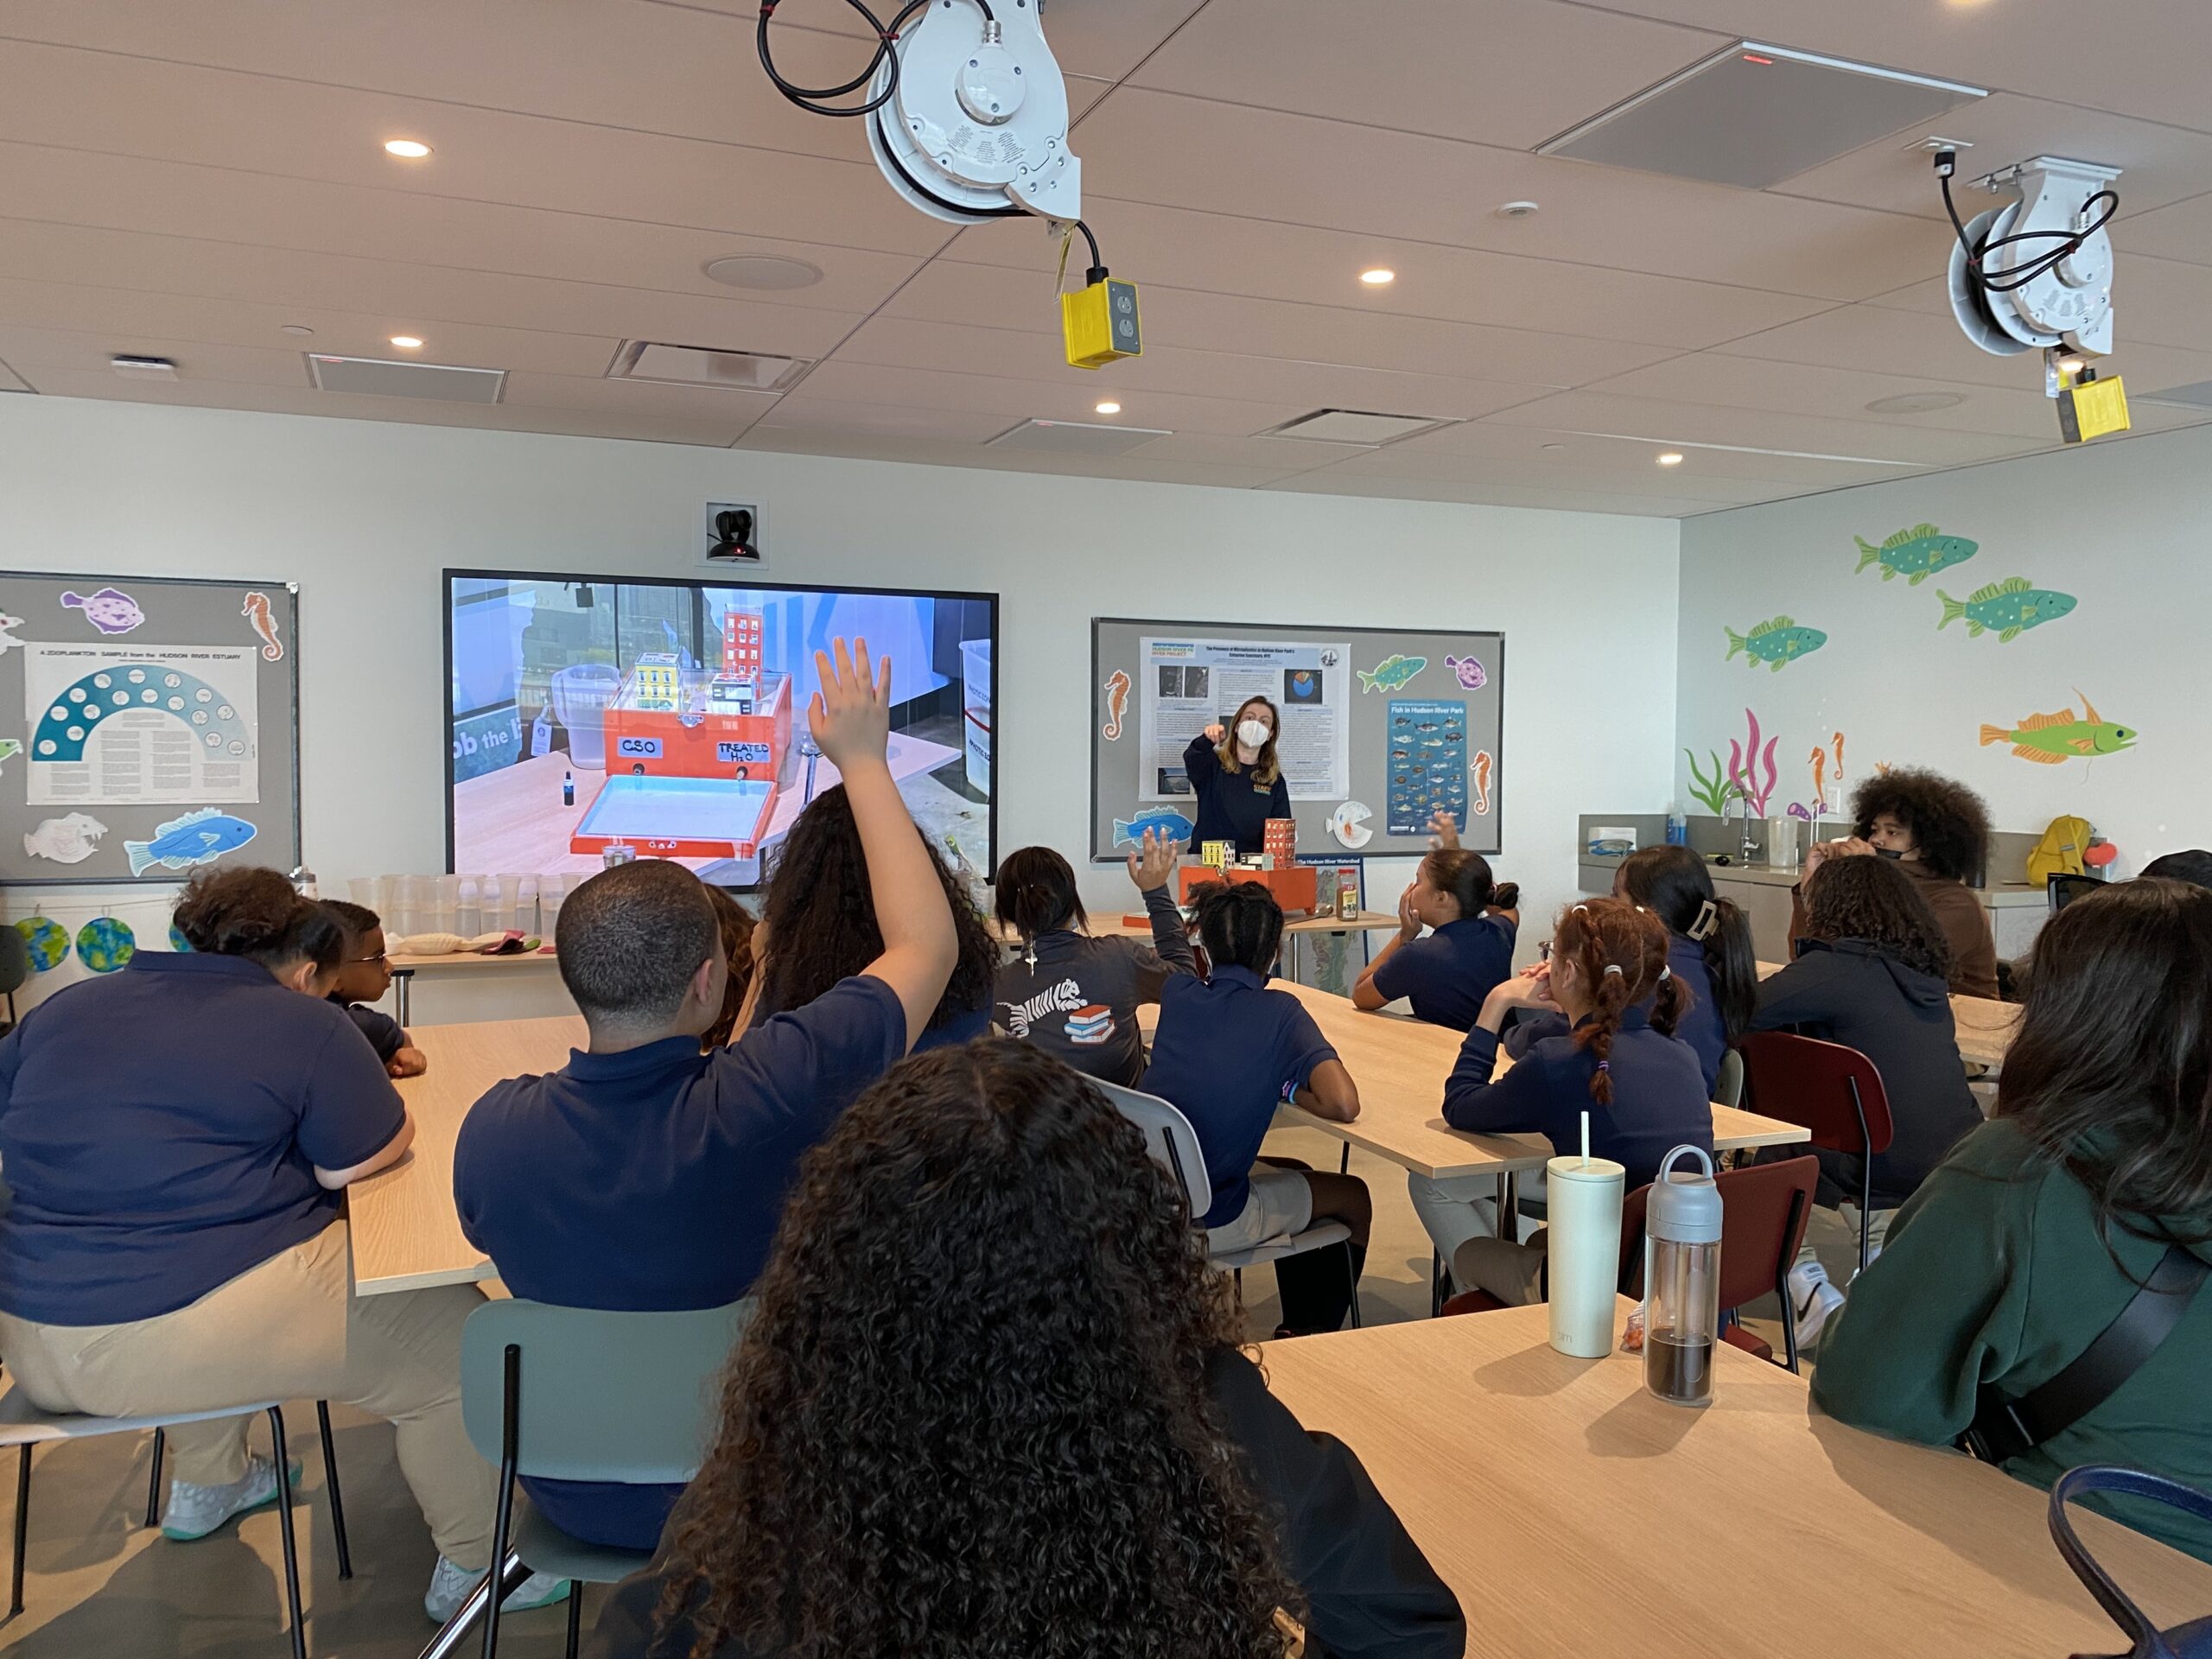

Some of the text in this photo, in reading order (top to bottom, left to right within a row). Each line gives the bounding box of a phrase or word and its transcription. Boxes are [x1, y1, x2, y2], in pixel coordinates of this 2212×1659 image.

[481, 730, 508, 749] the
[622, 740, 656, 753] CSO
[719, 742, 770, 753] TREATED
